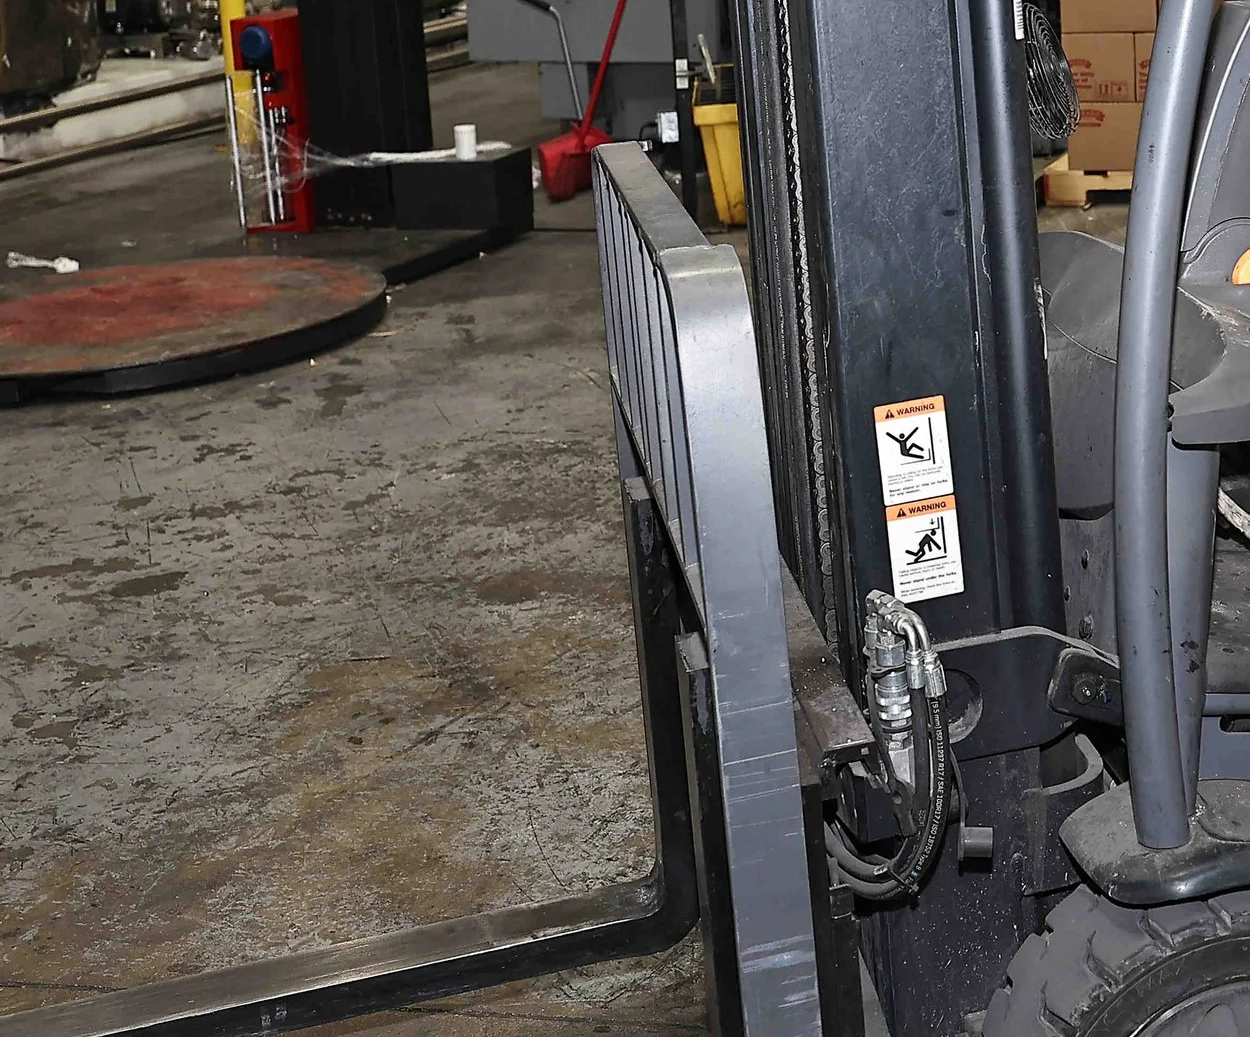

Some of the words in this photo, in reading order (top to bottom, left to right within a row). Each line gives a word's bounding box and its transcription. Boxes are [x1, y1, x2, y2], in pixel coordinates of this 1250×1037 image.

[896, 402, 935, 416] WARNING
[908, 501, 947, 514] WARNING
[935, 729, 943, 741] ISO
[936, 741, 945, 762] 11237
[937, 762, 945, 776] R17
